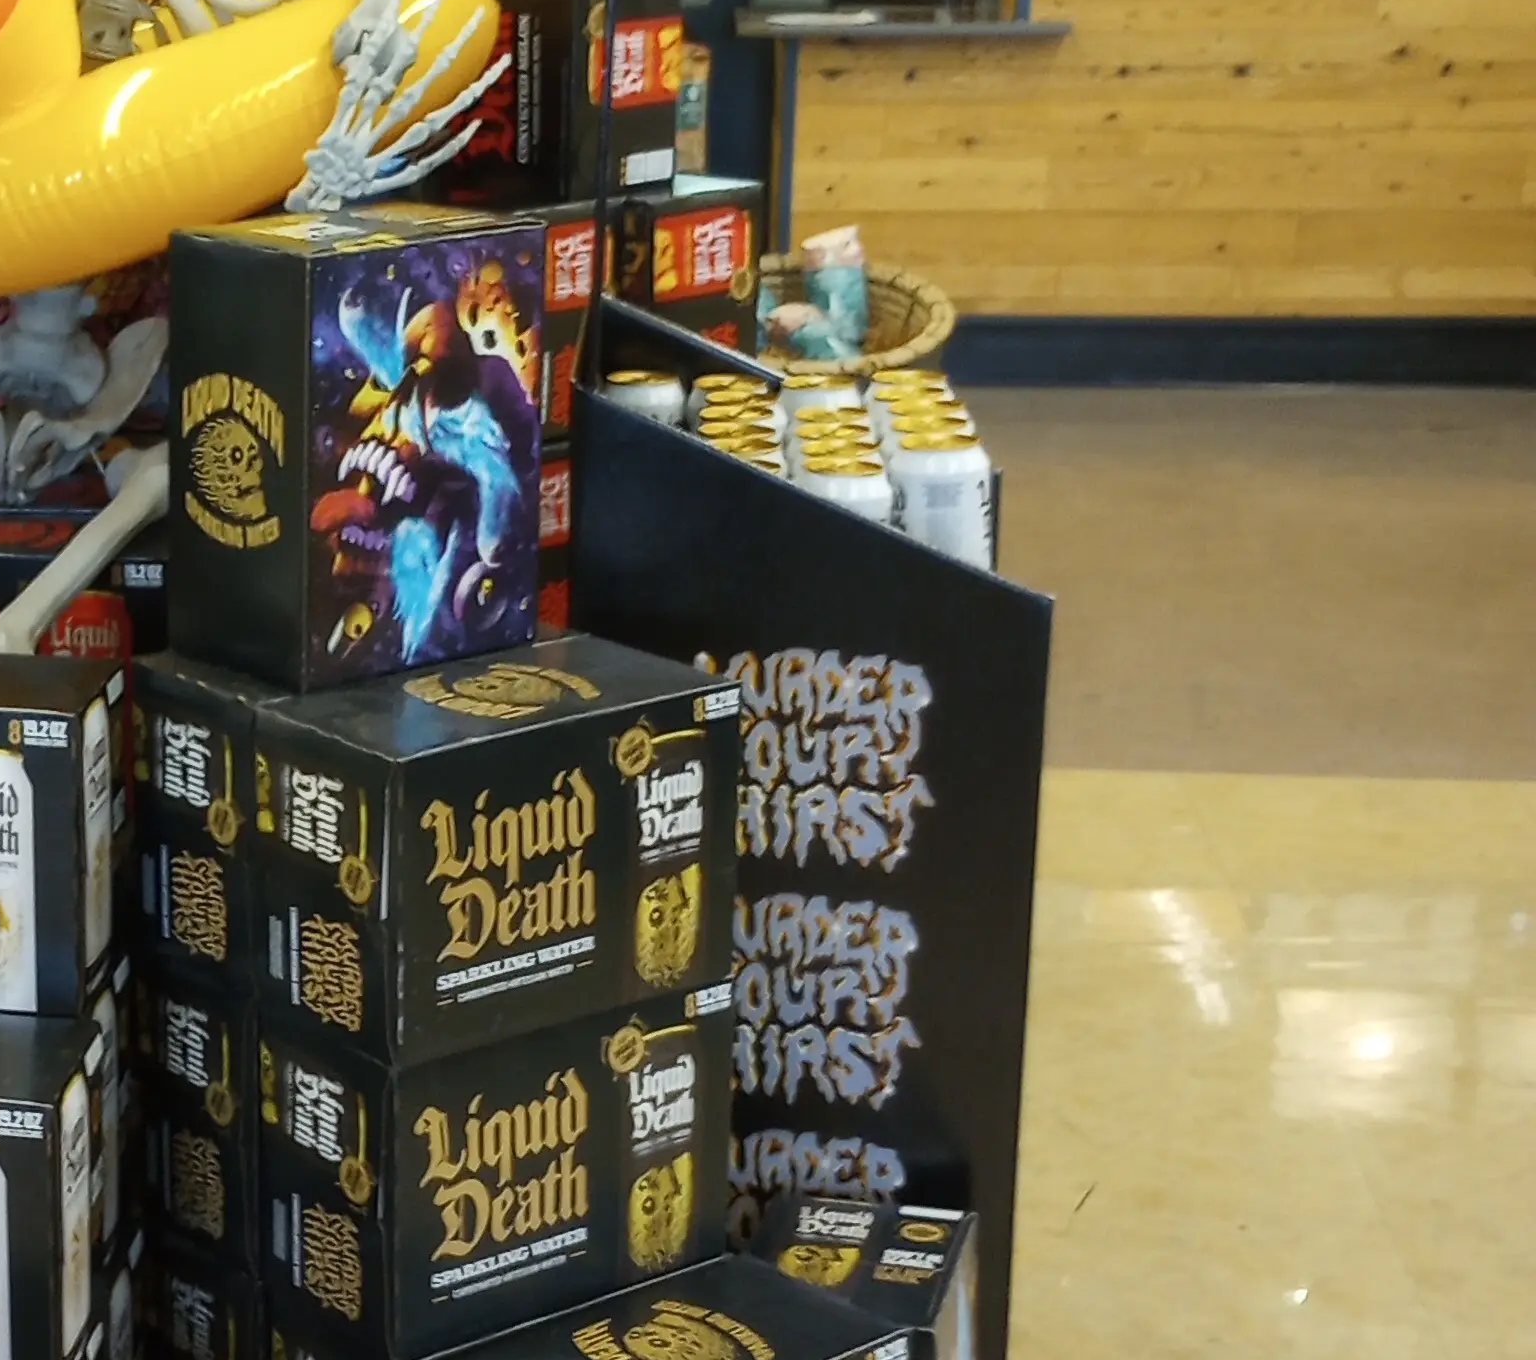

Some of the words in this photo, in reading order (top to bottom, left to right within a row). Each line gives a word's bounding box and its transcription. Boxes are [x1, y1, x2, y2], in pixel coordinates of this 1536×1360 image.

[696, 647, 934, 725] URDER
[181, 724, 212, 809] Liquid
[636, 758, 705, 812] Liquid
[737, 707, 922, 787] OUR
[288, 766, 319, 855] Death
[315, 767, 346, 866] Liquid
[419, 765, 598, 884] Liquid
[638, 797, 705, 847] Death
[736, 773, 936, 874] HIRST
[435, 851, 599, 964] Death
[732, 893, 920, 968] URDER
[731, 957, 910, 1028] OUR
[293, 1066, 321, 1150] Death
[316, 1077, 346, 1162] Liquid
[412, 1065, 592, 1189] Liquid
[727, 1128, 907, 1196] URDER
[430, 1146, 592, 1264] Death
[430, 1244, 531, 1289] SPARKLING
